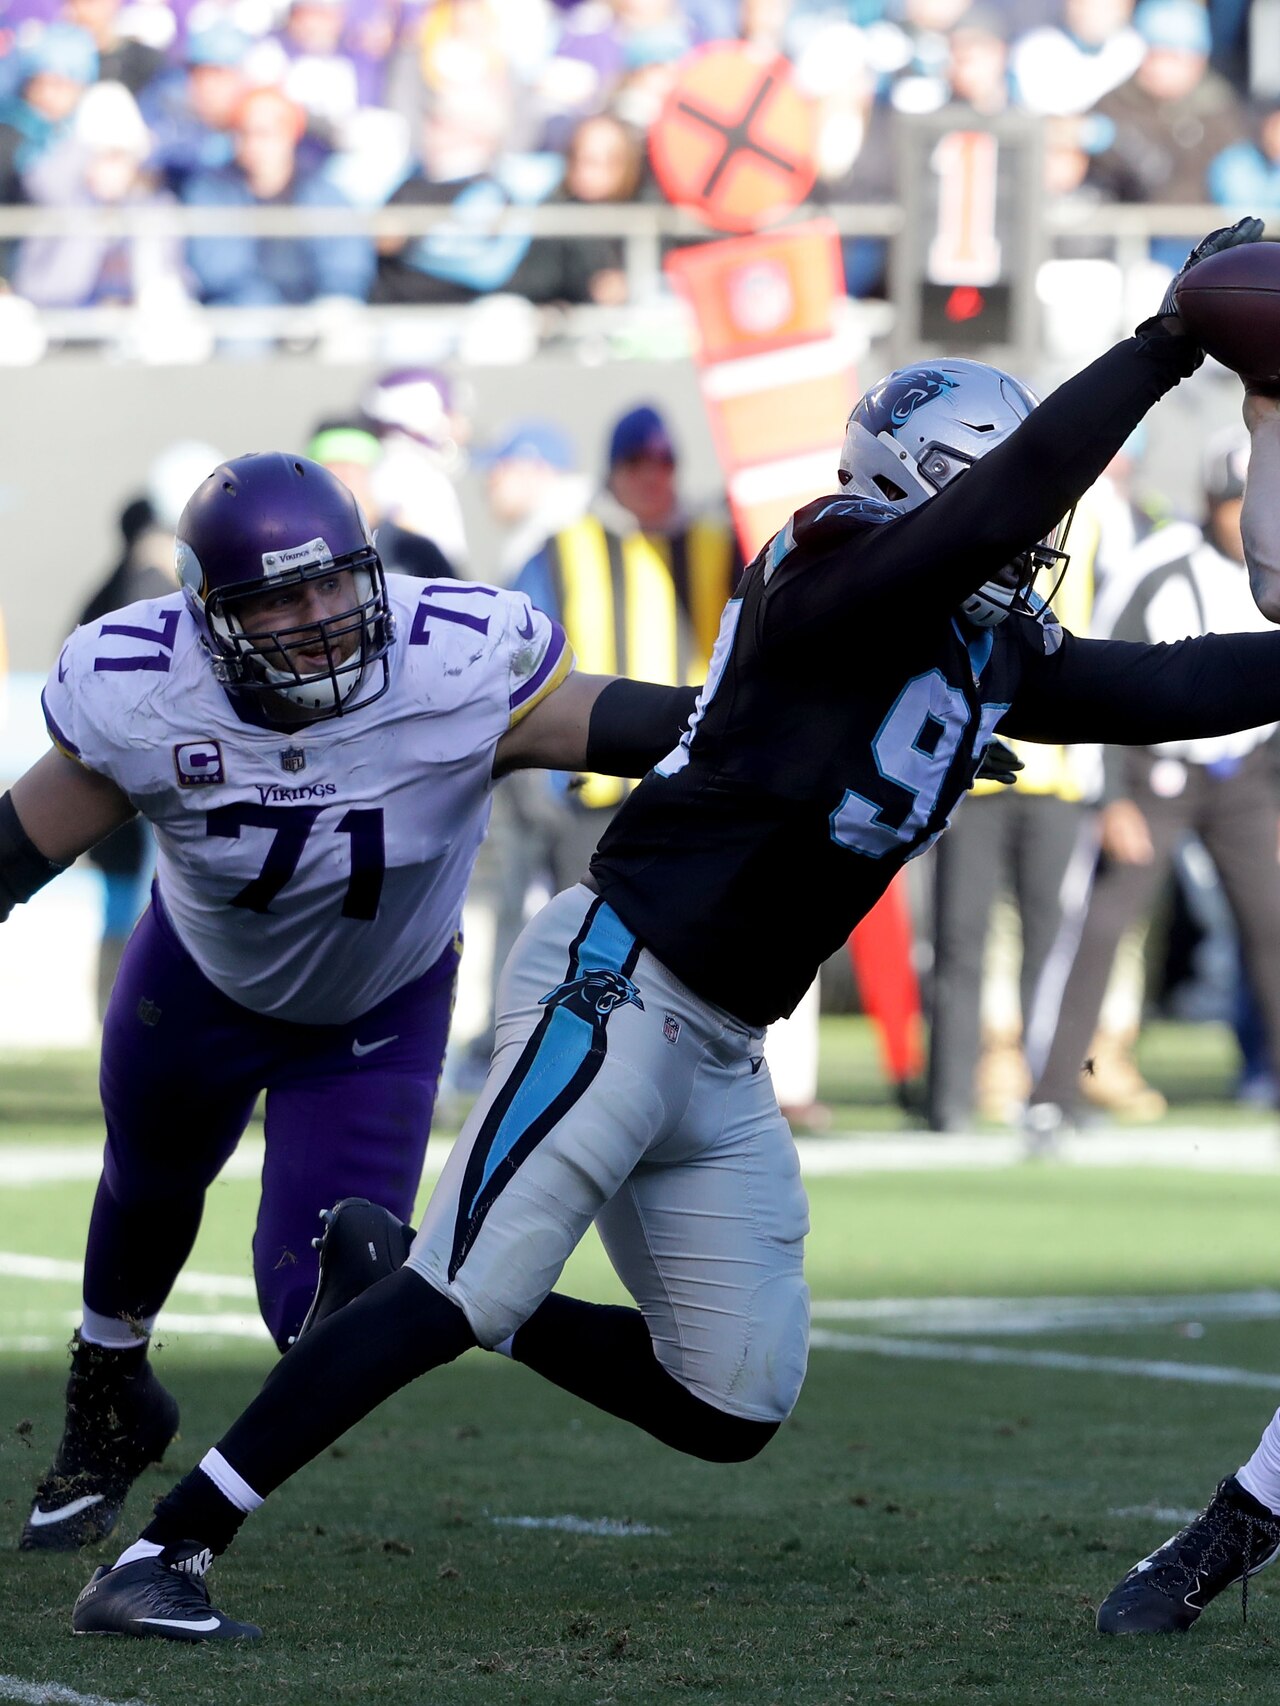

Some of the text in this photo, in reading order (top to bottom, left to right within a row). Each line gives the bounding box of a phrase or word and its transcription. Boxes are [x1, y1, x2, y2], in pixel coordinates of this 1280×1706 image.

[94, 610, 182, 672] 71
[409, 585, 498, 645] 71
[178, 743, 220, 775] C
[284, 757, 302, 770] NFL
[207, 802, 386, 921] 71
